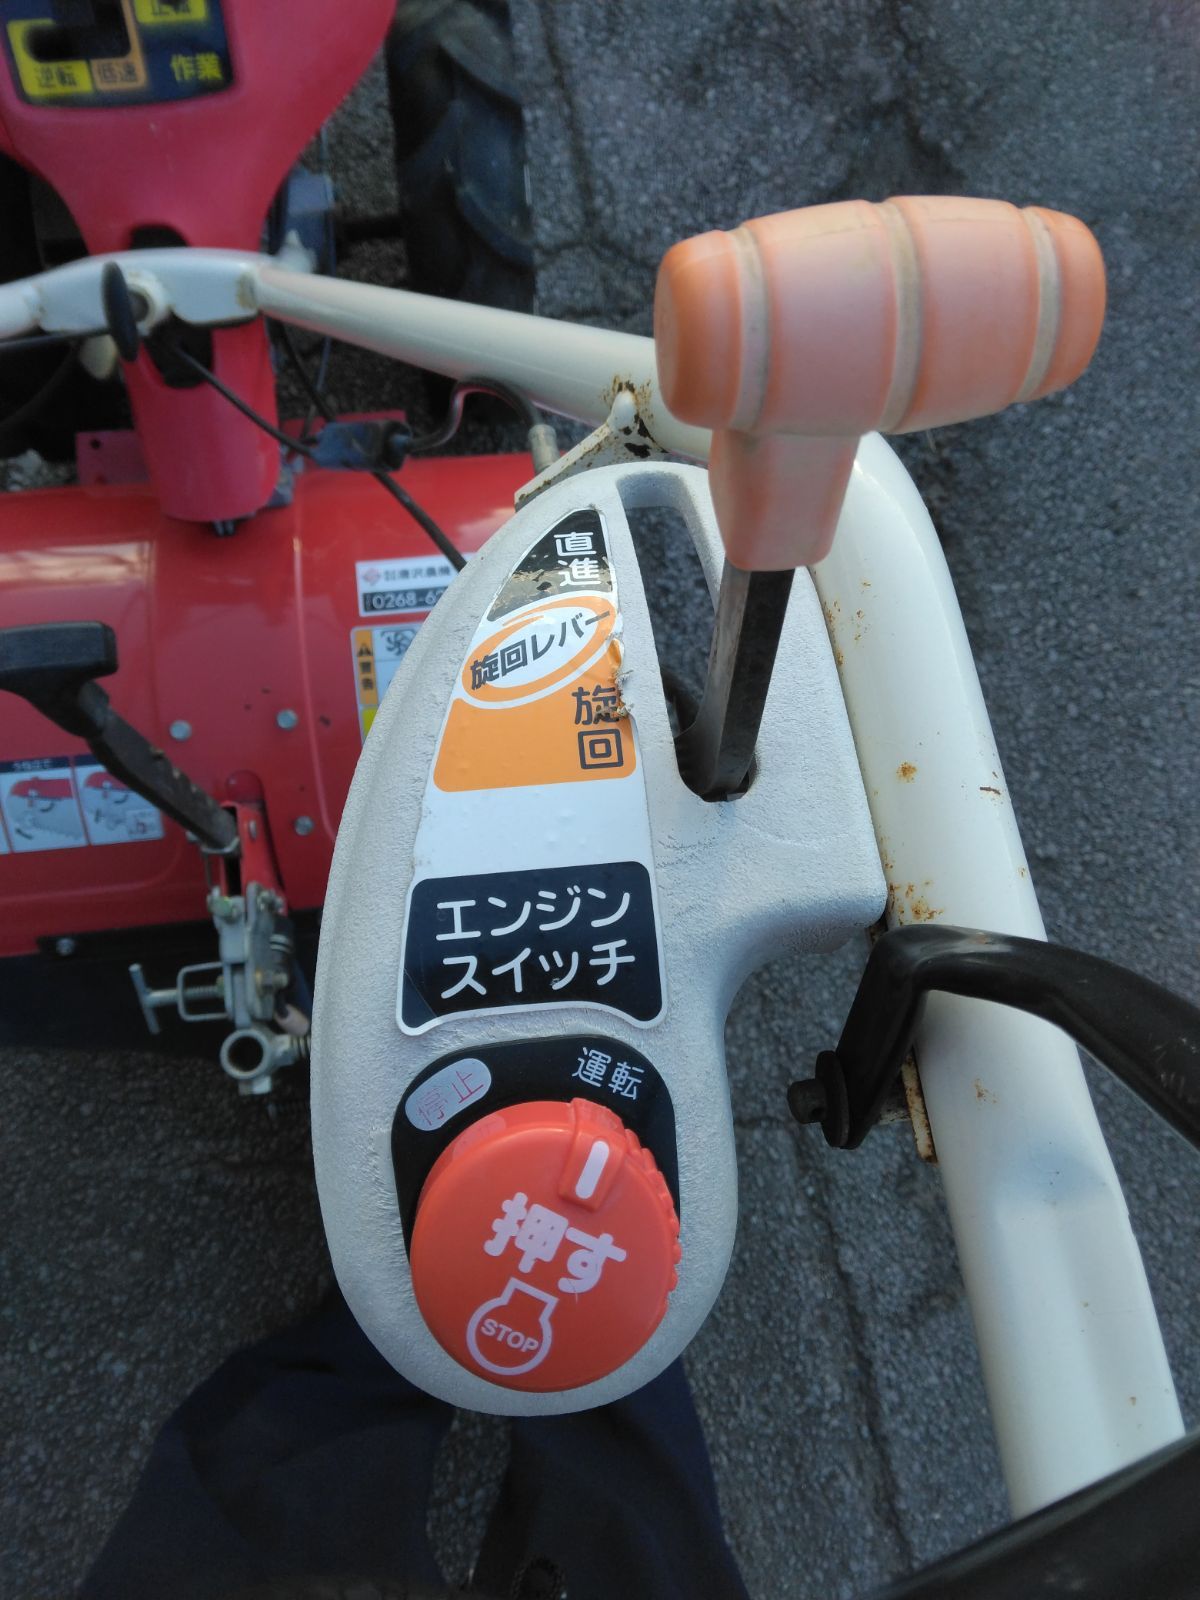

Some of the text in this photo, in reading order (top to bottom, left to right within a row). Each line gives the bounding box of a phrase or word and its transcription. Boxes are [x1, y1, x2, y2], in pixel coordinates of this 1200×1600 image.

[170, 52, 223, 83] 作業
[554, 532, 601, 587] 直進
[470, 611, 610, 690] 旋回レバー
[571, 684, 624, 770] 旋回
[436, 885, 630, 941] エンジン
[441, 939, 636, 999] スイッチ
[415, 1070, 484, 1126] 停止
[572, 1047, 645, 1101] 運転
[483, 1192, 627, 1294] 押す
[480, 1318, 539, 1353] STOP
